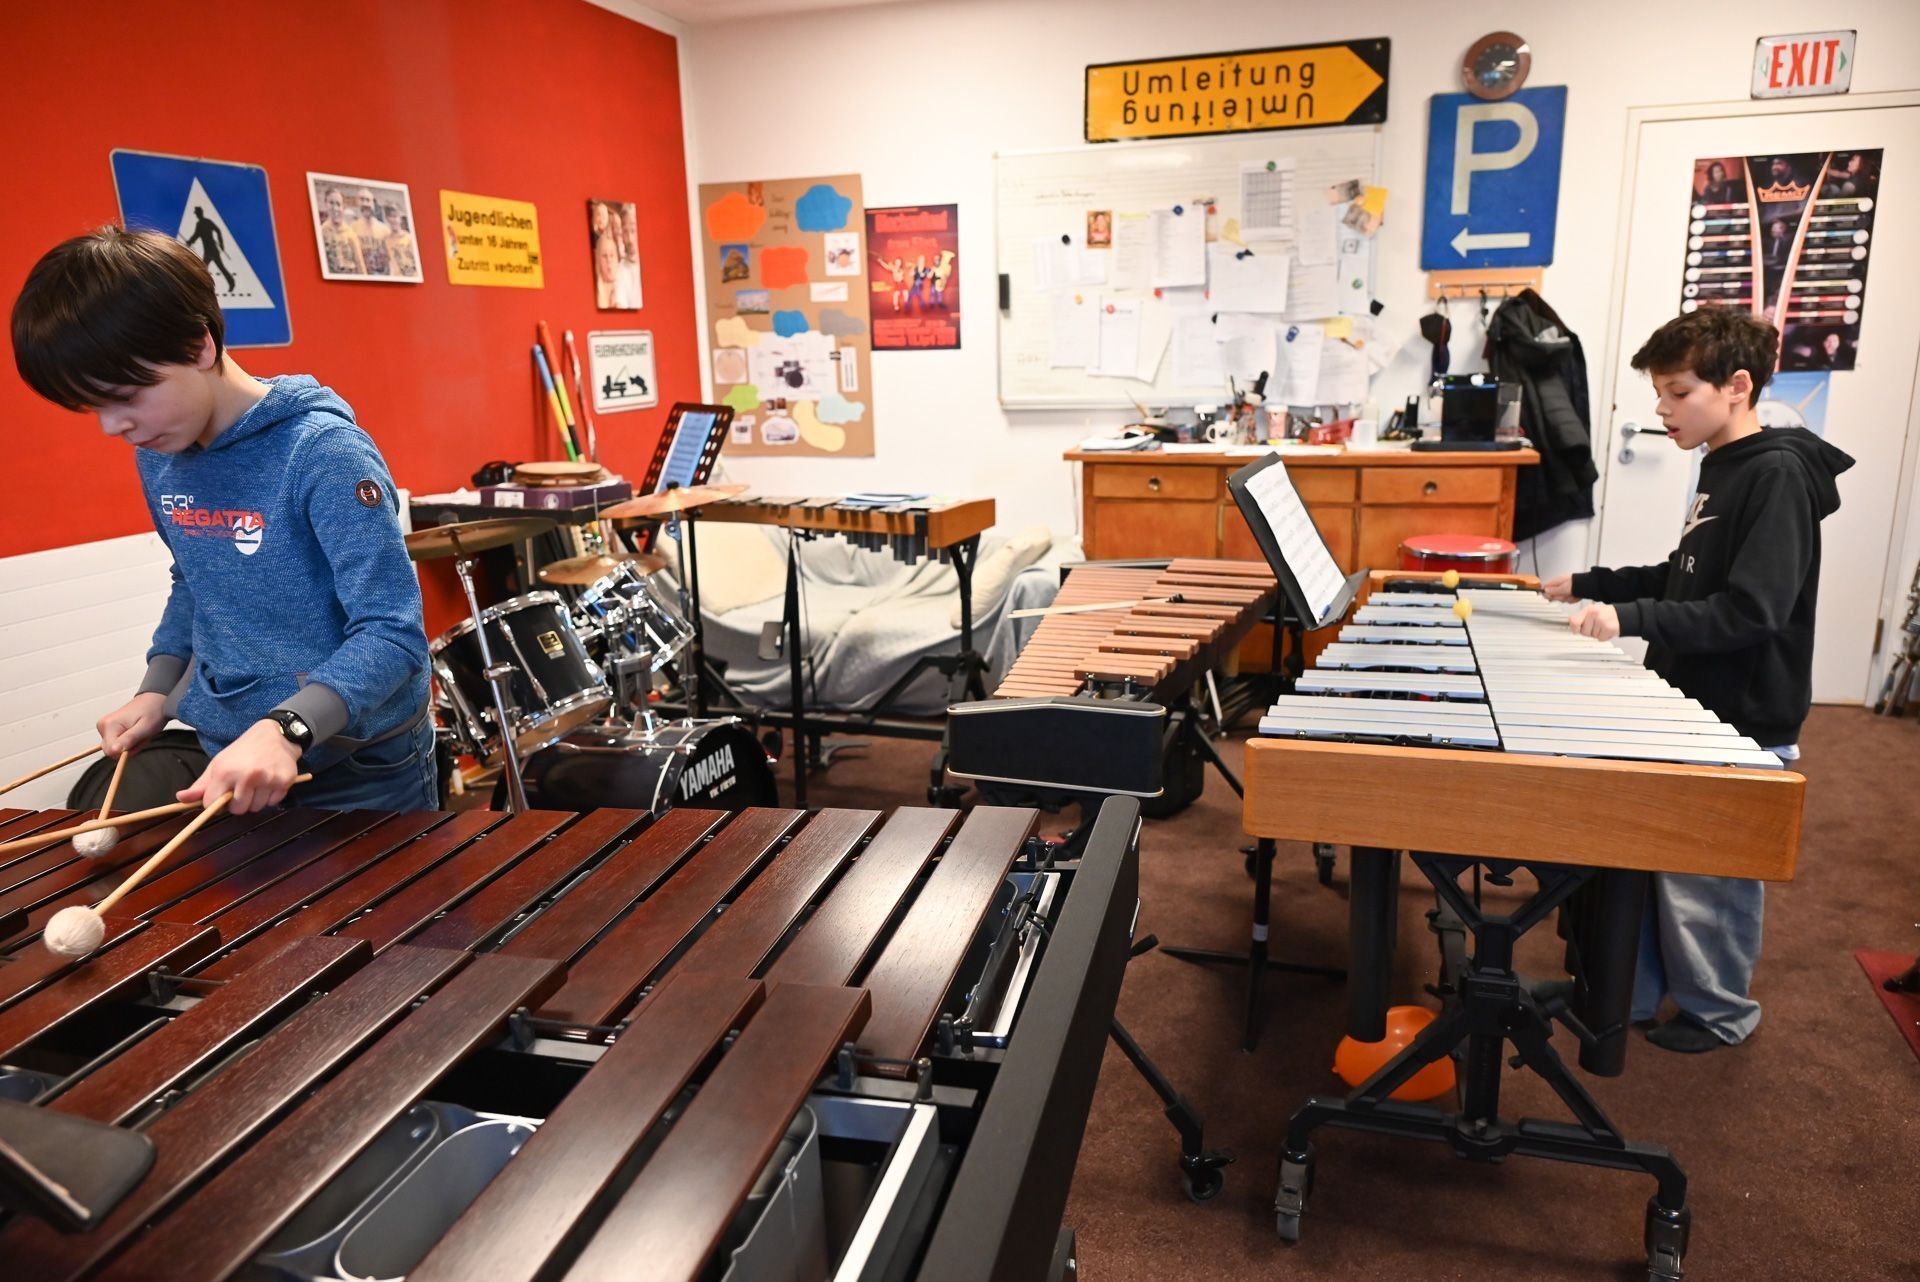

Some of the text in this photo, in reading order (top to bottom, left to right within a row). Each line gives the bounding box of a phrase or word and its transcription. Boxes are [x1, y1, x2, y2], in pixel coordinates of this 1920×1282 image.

[1123, 62, 1314, 95] Umleitung
[1769, 40, 1840, 88] EXIT
[1123, 92, 1314, 126] Umleitung
[1451, 102, 1539, 215] P
[447, 204, 533, 230] Jugendlichen
[457, 257, 534, 274] Zutritt verboten
[171, 509, 266, 529] REGATTA
[680, 744, 735, 800] YAMAHA
